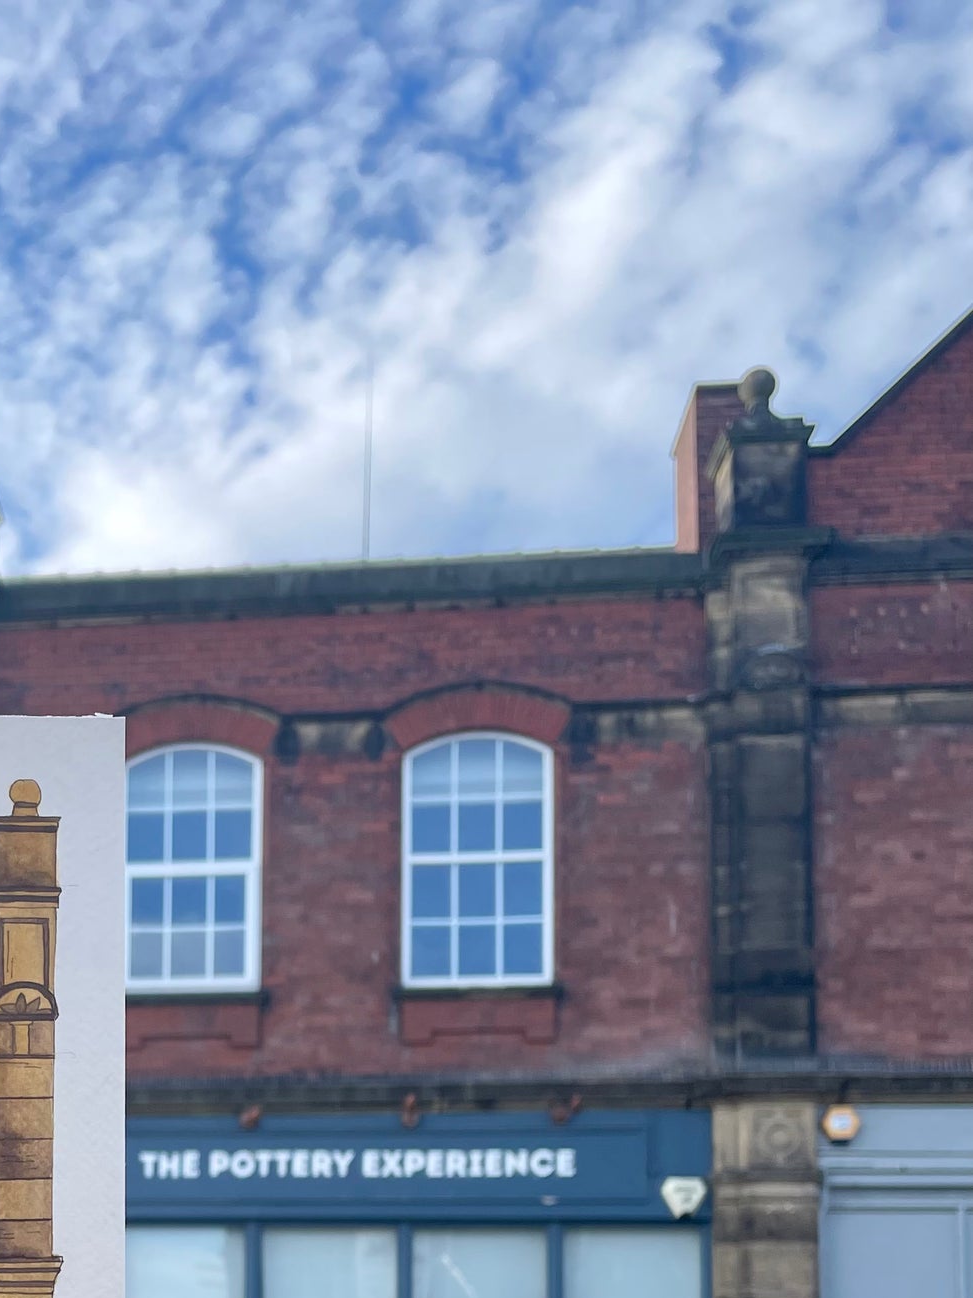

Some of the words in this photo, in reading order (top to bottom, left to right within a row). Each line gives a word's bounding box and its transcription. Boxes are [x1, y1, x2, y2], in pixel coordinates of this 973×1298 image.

[139, 1150, 201, 1180] THE
[208, 1148, 356, 1179] POTTERY
[361, 1147, 577, 1178] EXPERIENCE
